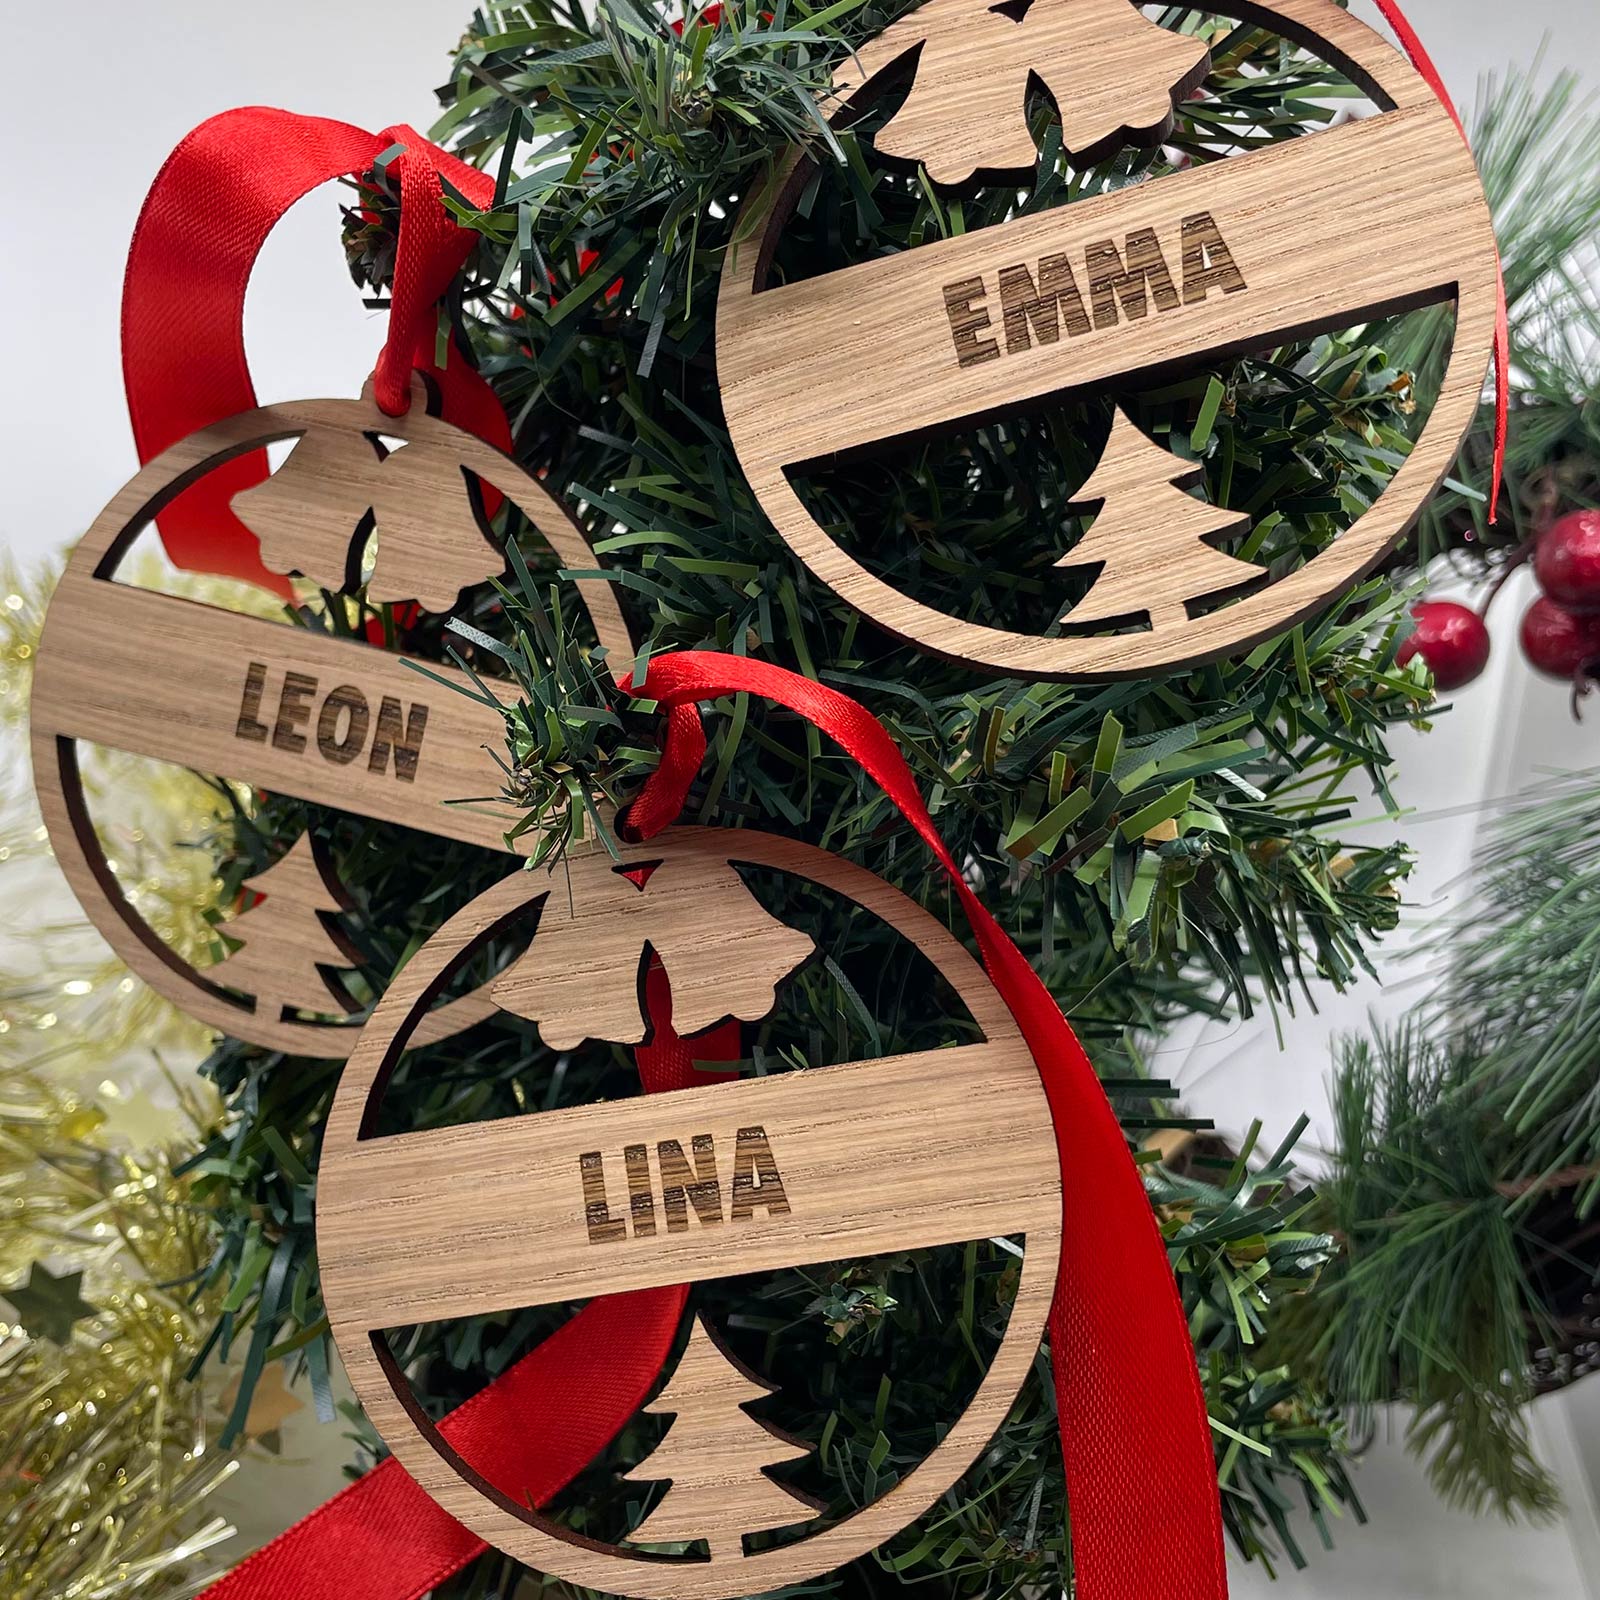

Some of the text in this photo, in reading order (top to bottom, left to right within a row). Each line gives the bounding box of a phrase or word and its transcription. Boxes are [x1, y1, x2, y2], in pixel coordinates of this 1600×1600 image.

[942, 211, 1248, 369] EMMA
[235, 661, 429, 784] LEON
[579, 1125, 792, 1246] LINA
